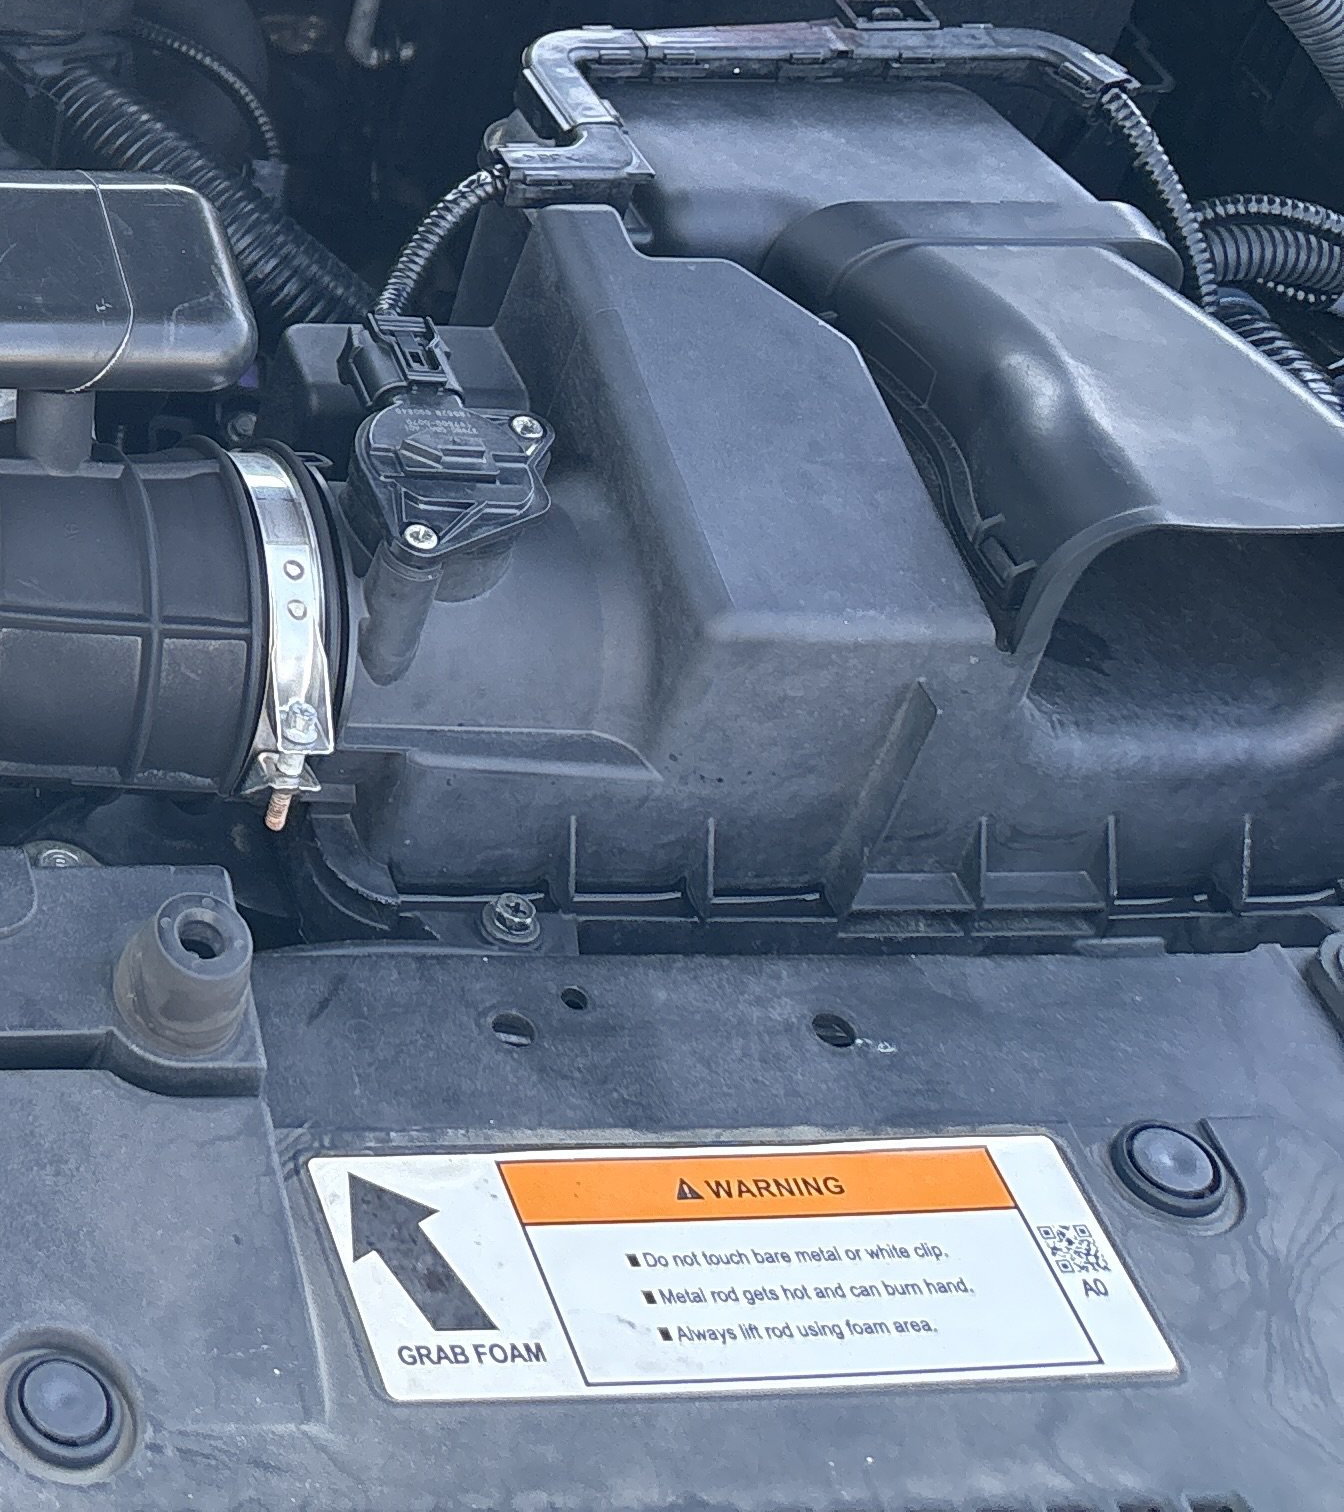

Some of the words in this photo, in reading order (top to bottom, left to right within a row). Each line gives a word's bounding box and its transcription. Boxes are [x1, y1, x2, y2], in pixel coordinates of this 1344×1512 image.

[704, 1175, 846, 1200] WARNING
[642, 1251, 669, 1268] Do
[672, 1251, 702, 1268] not
[701, 1249, 752, 1266] touch
[750, 1248, 792, 1265] bare
[794, 1246, 842, 1264] metal
[845, 1248, 863, 1261] or
[864, 1243, 911, 1261] white
[913, 1242, 950, 1262] clip.
[658, 1287, 708, 1306] Metal
[710, 1286, 740, 1304] rod
[742, 1285, 780, 1307] gets
[780, 1284, 813, 1301] hot
[813, 1282, 847, 1300] and
[849, 1284, 883, 1298] can
[880, 1279, 924, 1297] burn
[923, 1276, 975, 1296] hand.
[1081, 1277, 1110, 1299] A0
[676, 1325, 738, 1346] Always
[738, 1322, 764, 1341] lift
[764, 1322, 795, 1340] rod
[795, 1320, 846, 1341] using
[845, 1318, 892, 1337] foam
[892, 1319, 939, 1334] area.
[397, 1343, 471, 1367] GRAB
[473, 1341, 548, 1364] FOAM
